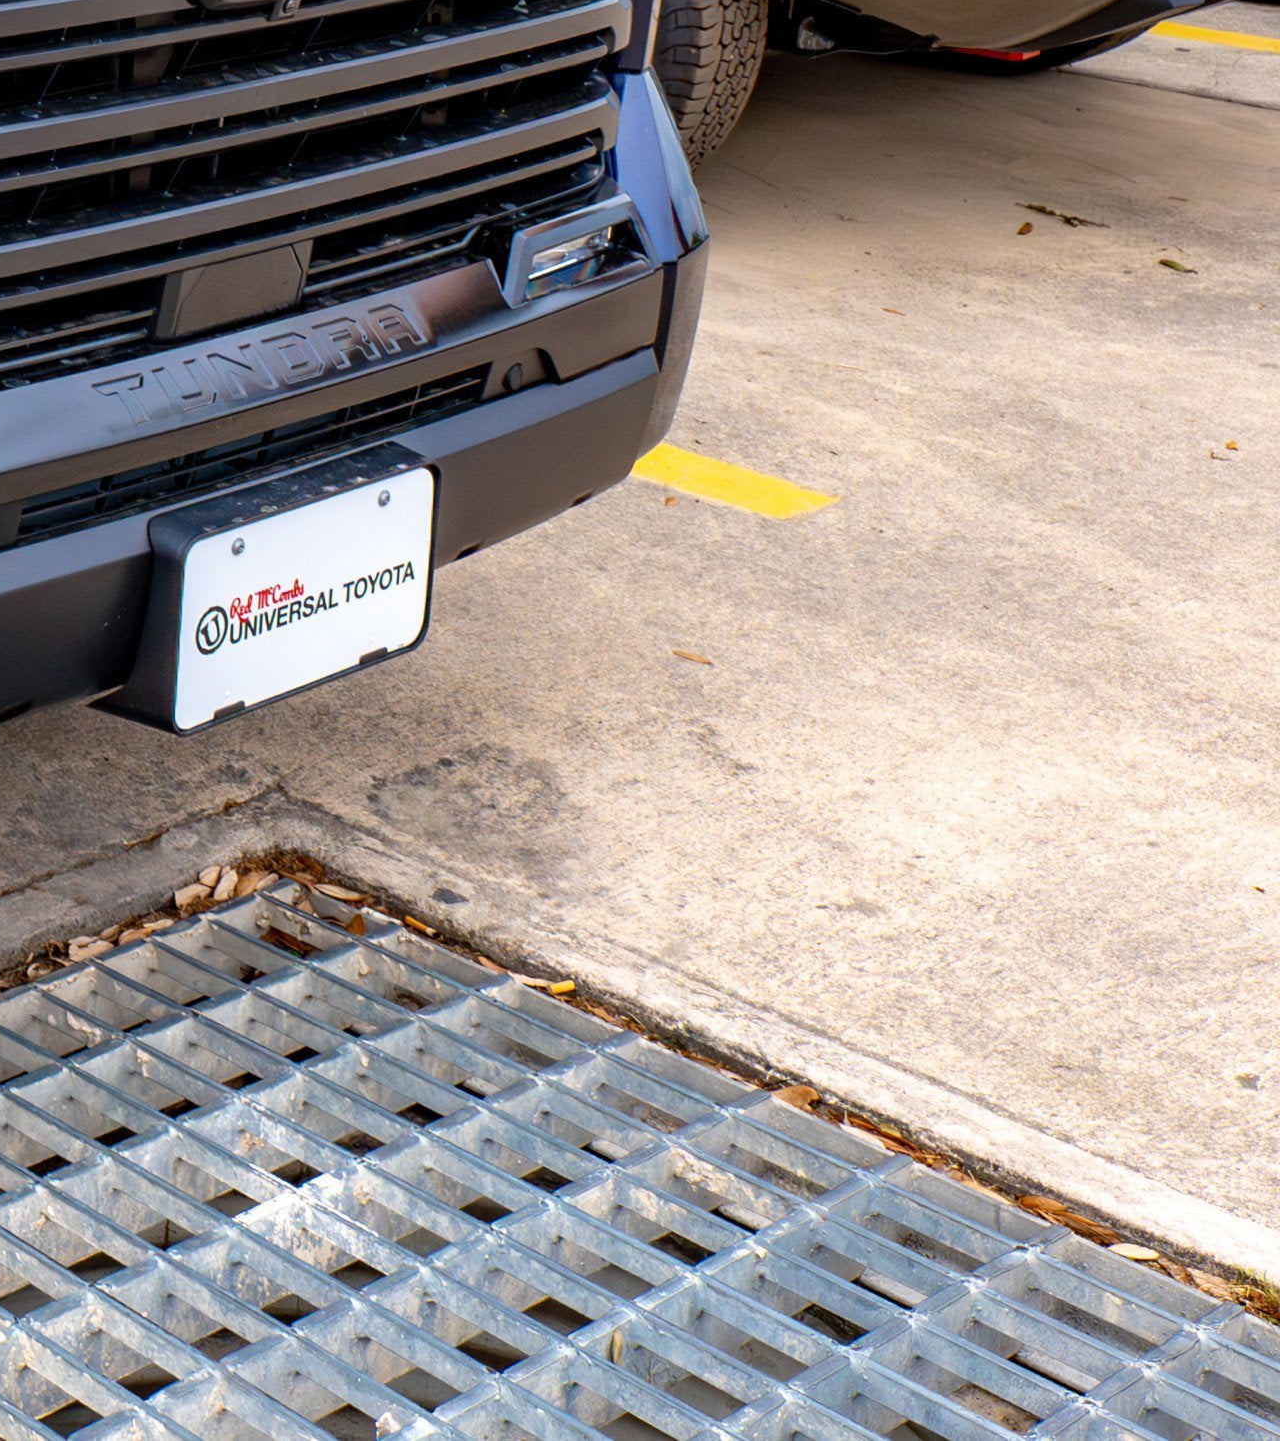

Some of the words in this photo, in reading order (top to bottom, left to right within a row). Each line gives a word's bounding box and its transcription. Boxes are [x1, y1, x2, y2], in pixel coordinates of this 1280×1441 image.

[91, 303, 430, 426] TUNDRA
[229, 587, 339, 645] UNIVERSAL
[343, 561, 415, 603] TOYOTA
[229, 594, 253, 624] Red
